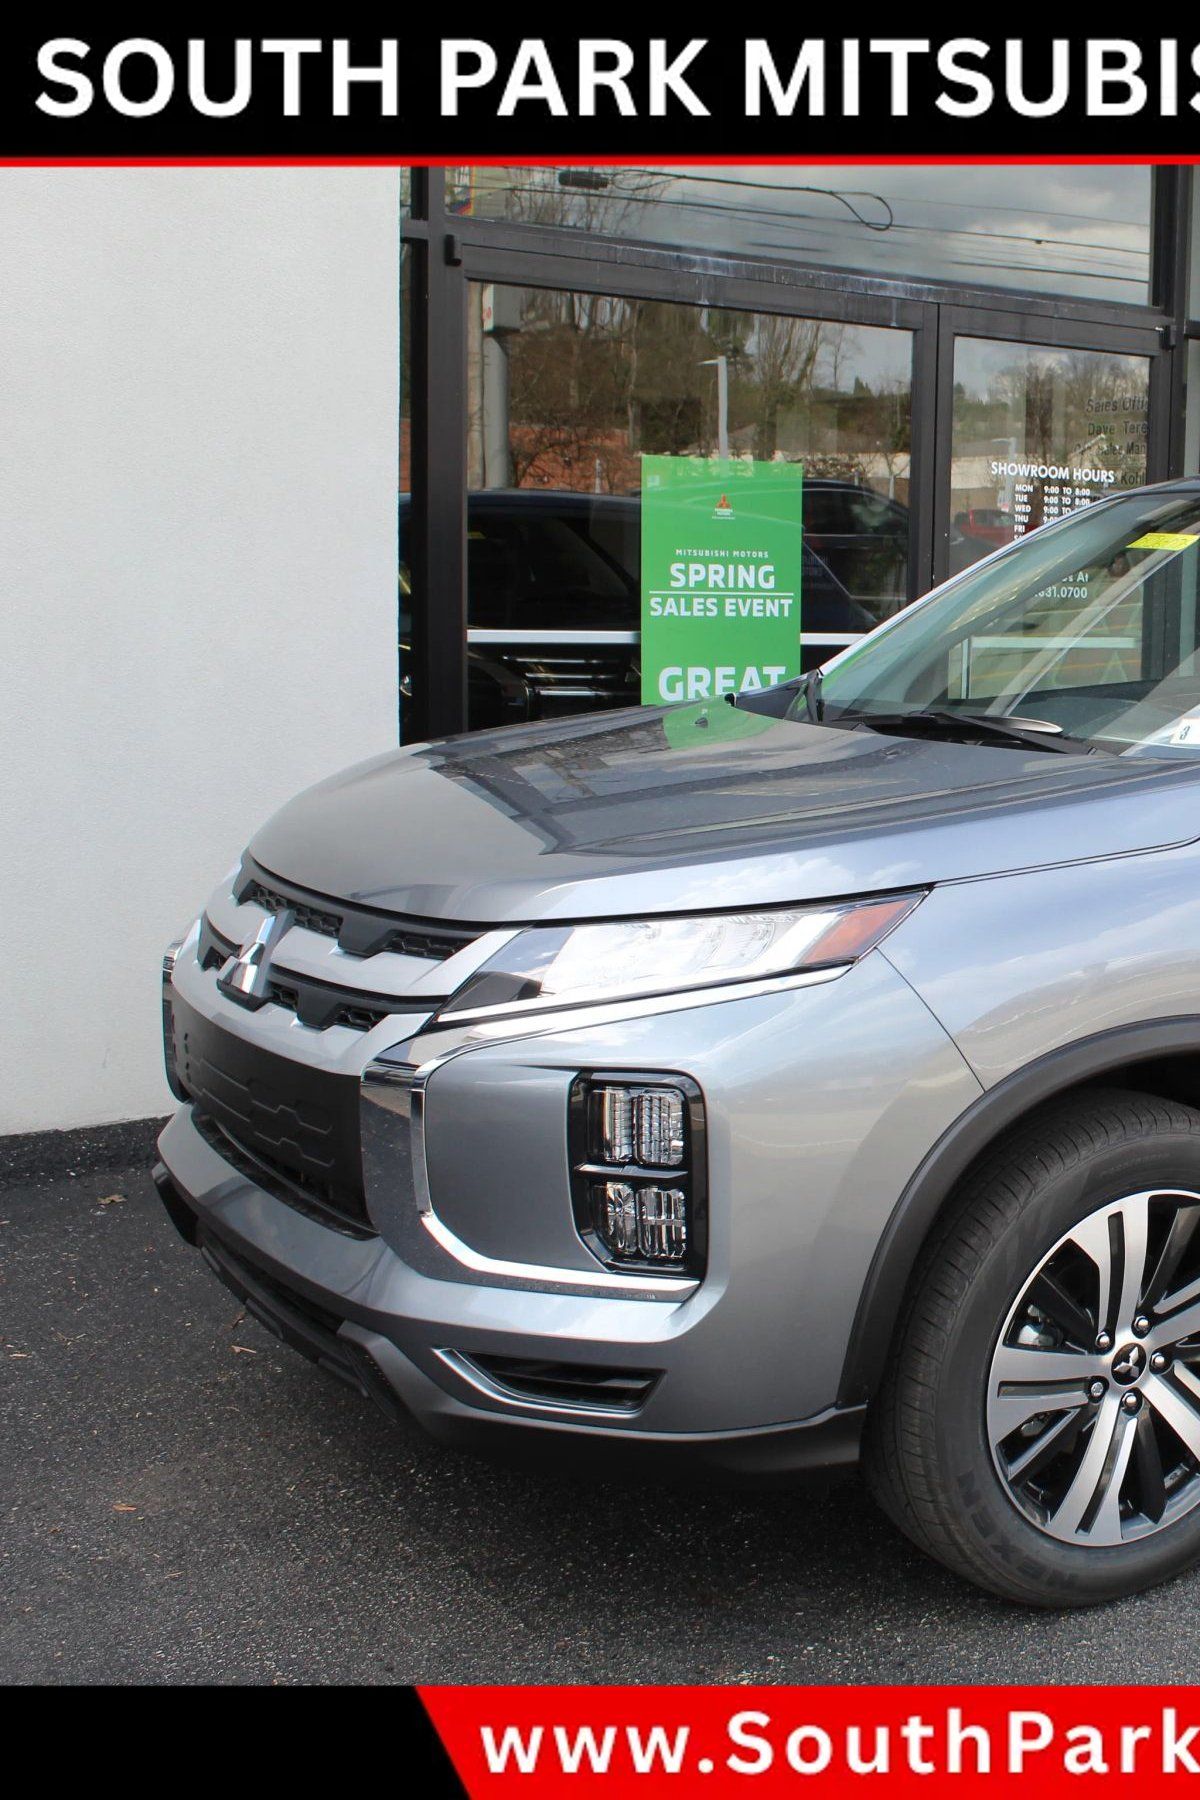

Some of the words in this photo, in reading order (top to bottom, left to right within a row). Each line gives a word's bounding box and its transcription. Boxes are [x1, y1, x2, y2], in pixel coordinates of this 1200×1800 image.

[1088, 422, 1116, 437] Dave
[991, 461, 1070, 480] SHOWROOM
[1073, 467, 1115, 483] HOURS
[1014, 484, 1034, 493] MON
[1043, 485, 1060, 495] 9:00
[1063, 486, 1072, 495] TO
[1074, 487, 1091, 497] 8:00
[1014, 494, 1028, 503] TUE
[1043, 495, 1059, 504] 9:00
[1062, 496, 1072, 505] TO
[1014, 504, 1032, 513] WED
[1043, 506, 1059, 514] 9:00
[1014, 514, 1029, 523] THU
[1013, 524, 1026, 533] FRI
[675, 548, 729, 558] MITSUBISHI
[733, 550, 769, 559] MOTORS
[669, 562, 776, 591] SPRING
[650, 596, 718, 618] SALES
[724, 597, 793, 618] EVENT
[658, 665, 786, 702] GREAT
